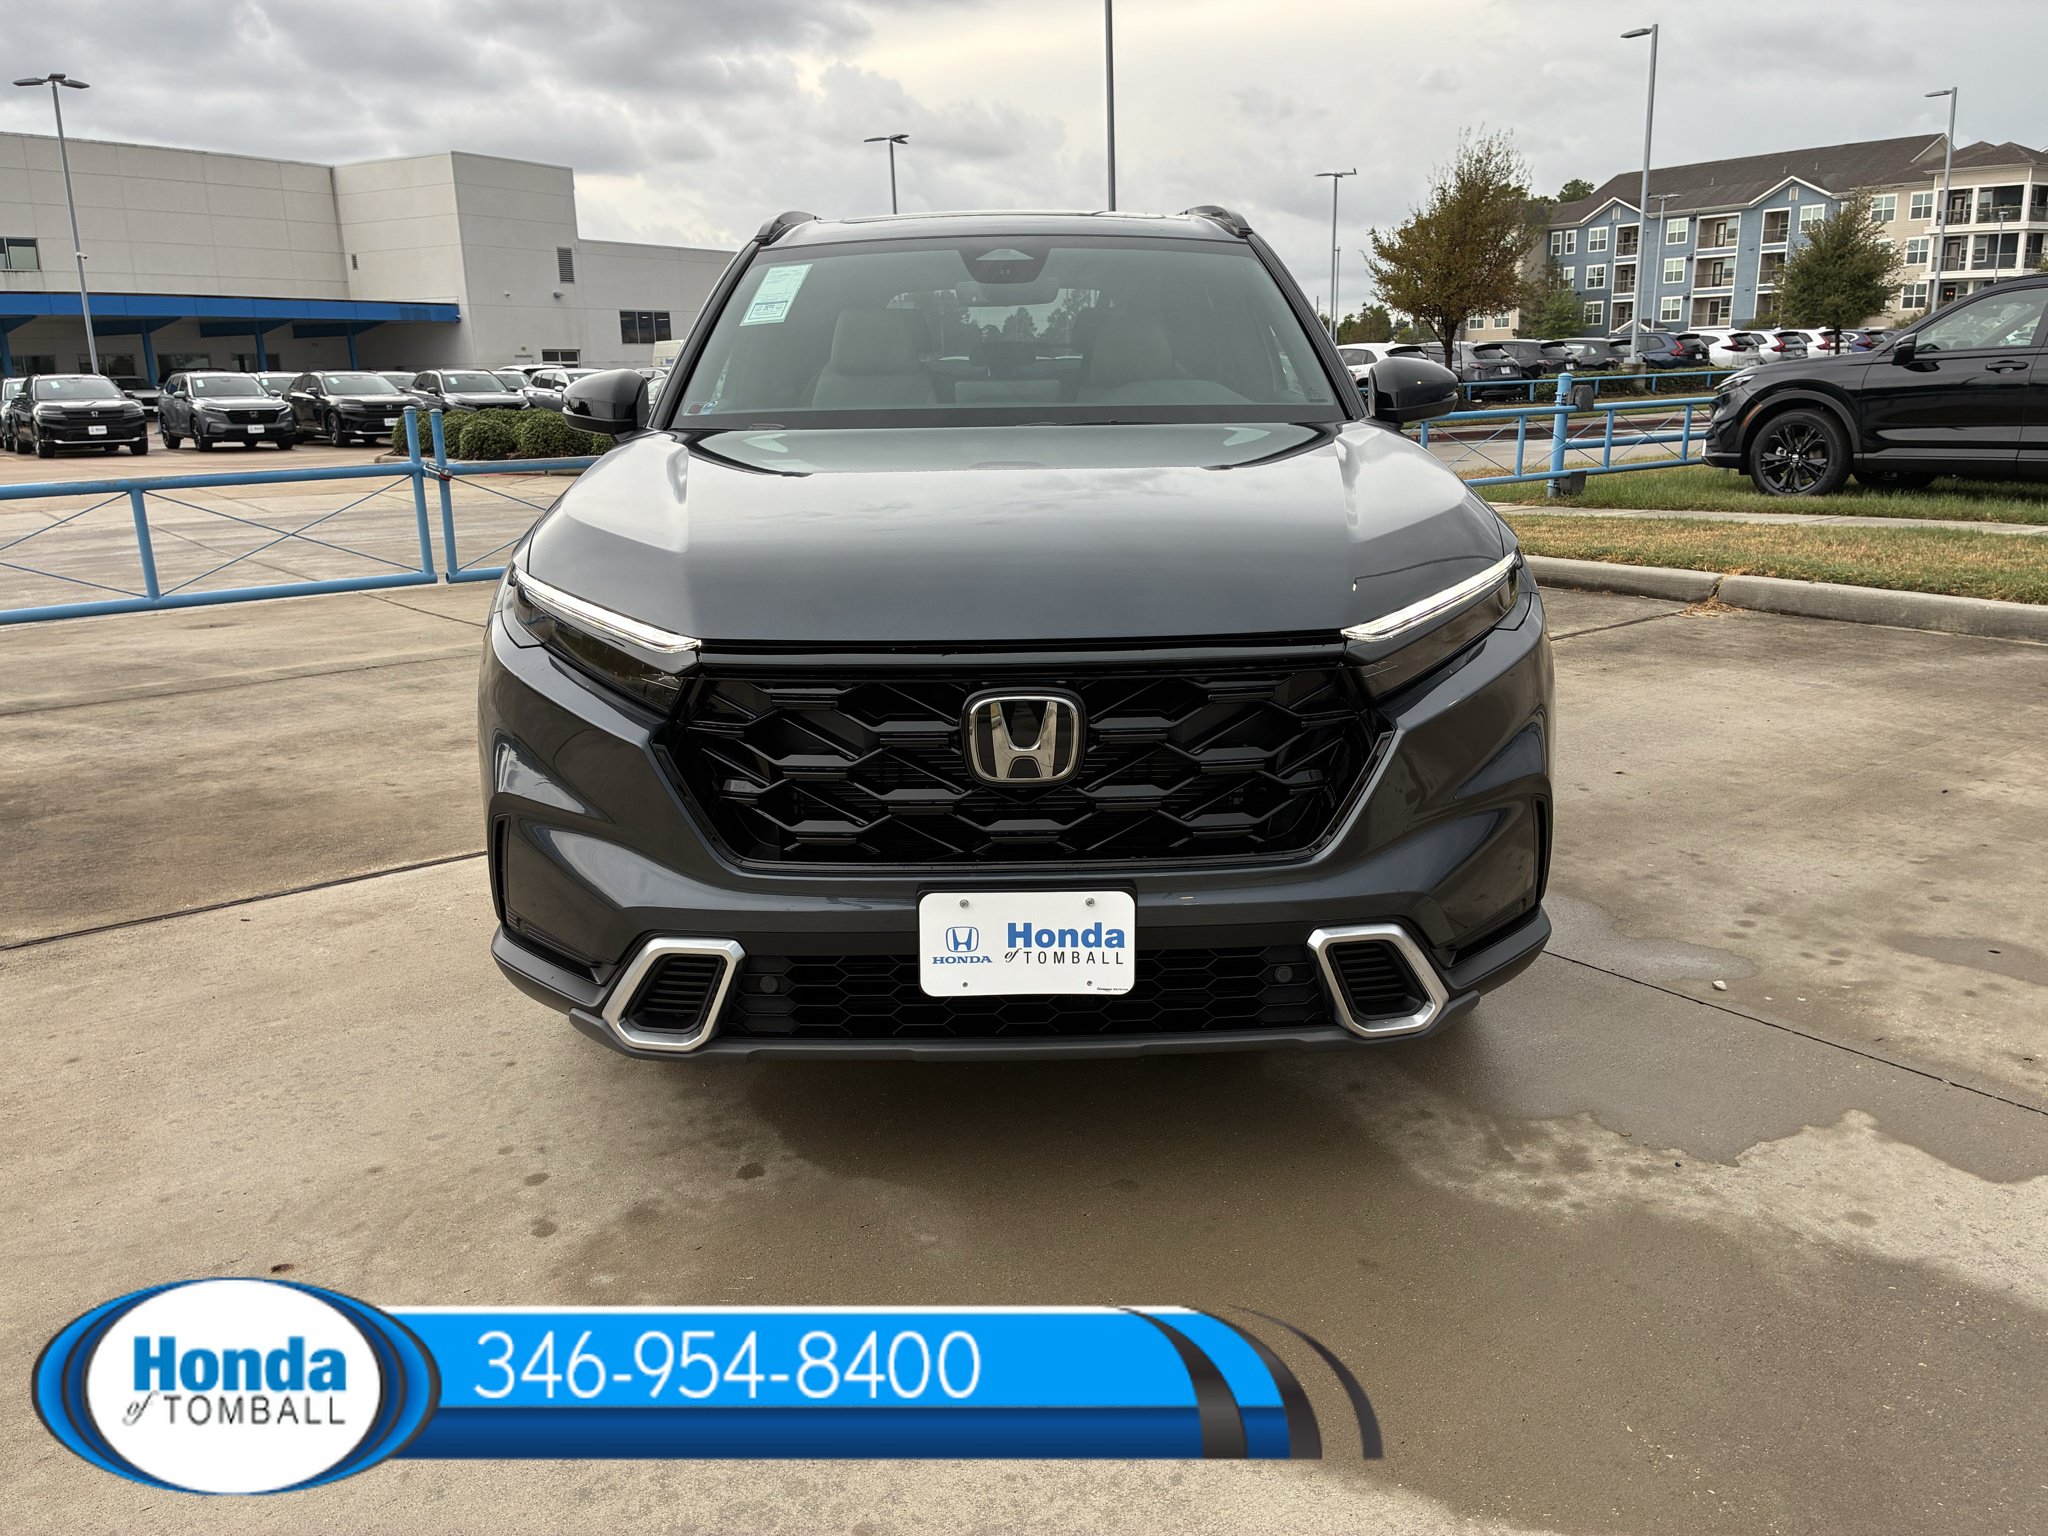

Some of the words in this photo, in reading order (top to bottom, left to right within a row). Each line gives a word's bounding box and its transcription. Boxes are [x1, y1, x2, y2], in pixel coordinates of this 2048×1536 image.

[1007, 922, 1126, 949] Honda
[932, 956, 993, 965] HONDA
[1004, 947, 1023, 963] of
[1023, 951, 1124, 965] TOMBALL
